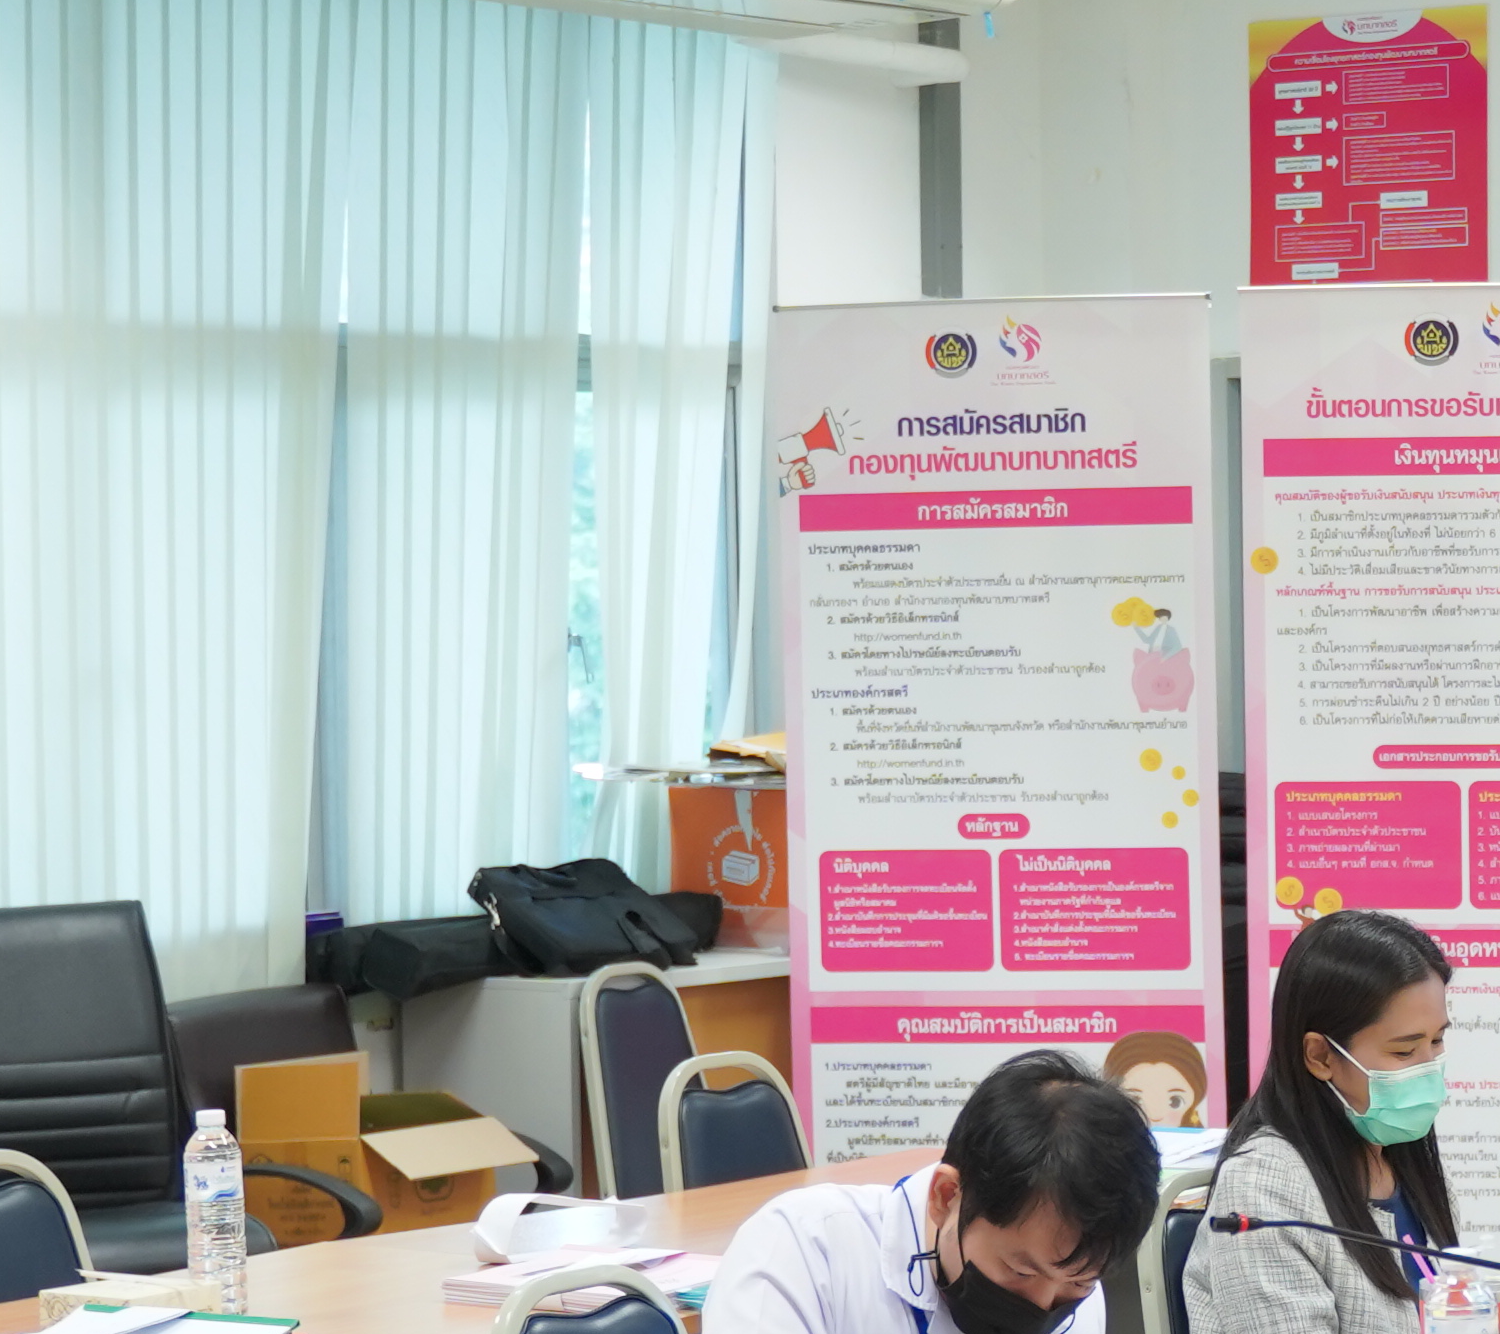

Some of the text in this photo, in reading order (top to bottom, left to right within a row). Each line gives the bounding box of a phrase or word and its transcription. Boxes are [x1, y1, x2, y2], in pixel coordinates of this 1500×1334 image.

[897, 408, 1086, 437] การสมัครสมาชิก
[849, 441, 1137, 481] กองทุนพัฒนาบทบาทสตรี
[1275, 489, 1434, 505] คุณสมบัติของผู้ขอรับเงินสนับสนุน
[918, 497, 1068, 522] การสมัครสมาชิก
[1434, 526, 1486, 539] ไม่น้อยกว่า
[808, 542, 921, 556] ประเภทบุคคลธรรมดา
[839, 560, 913, 571] สมัครด้วยตนเอง
[1276, 583, 1360, 599] หลักเกณฑ์พื้นฐาน
[1365, 585, 1472, 599] การขอรับการสนับสนุน
[1312, 604, 1427, 618] เป็นโครงการพัฒนาอาชีพ
[854, 631, 962, 643] http://womenfund.in.th
[1277, 624, 1327, 637] และองค์กร
[811, 684, 908, 699] ประเภทองค์กรสตรี
[1310, 677, 1439, 693] สามารถขอรับการสนับสนุนได้
[1433, 695, 1440, 706] ปี
[1445, 695, 1490, 708] อย่างน้อย
[842, 705, 917, 716] สมัครด้วยตนเอง
[857, 757, 964, 769] http://womenfund.in.th
[1286, 790, 1402, 806] ประเภทบุคคลธรรมดา
[1299, 808, 1378, 821] แบบเสนอโครงการ
[965, 818, 1018, 836] หลักฐาน
[1299, 825, 1426, 838] สำเนาบัตรประจำตัวประชาชน
[833, 858, 889, 874] นิติบุคคล
[1017, 853, 1111, 875] ไม่เป็นนิติบุคคล
[1341, 857, 1366, 868] ตามที่
[1403, 858, 1434, 868] กำหนด
[898, 1010, 1117, 1041] คุณสมบัติการเป็นสมาชิก
[826, 1061, 932, 1074] 1.ประเภทบุคคลธรรมดา
[846, 1077, 930, 1092] สตรีผู้มีสัญชาติไทย
[826, 1117, 919, 1129] 2.ประเภทองค์กรสตรี
